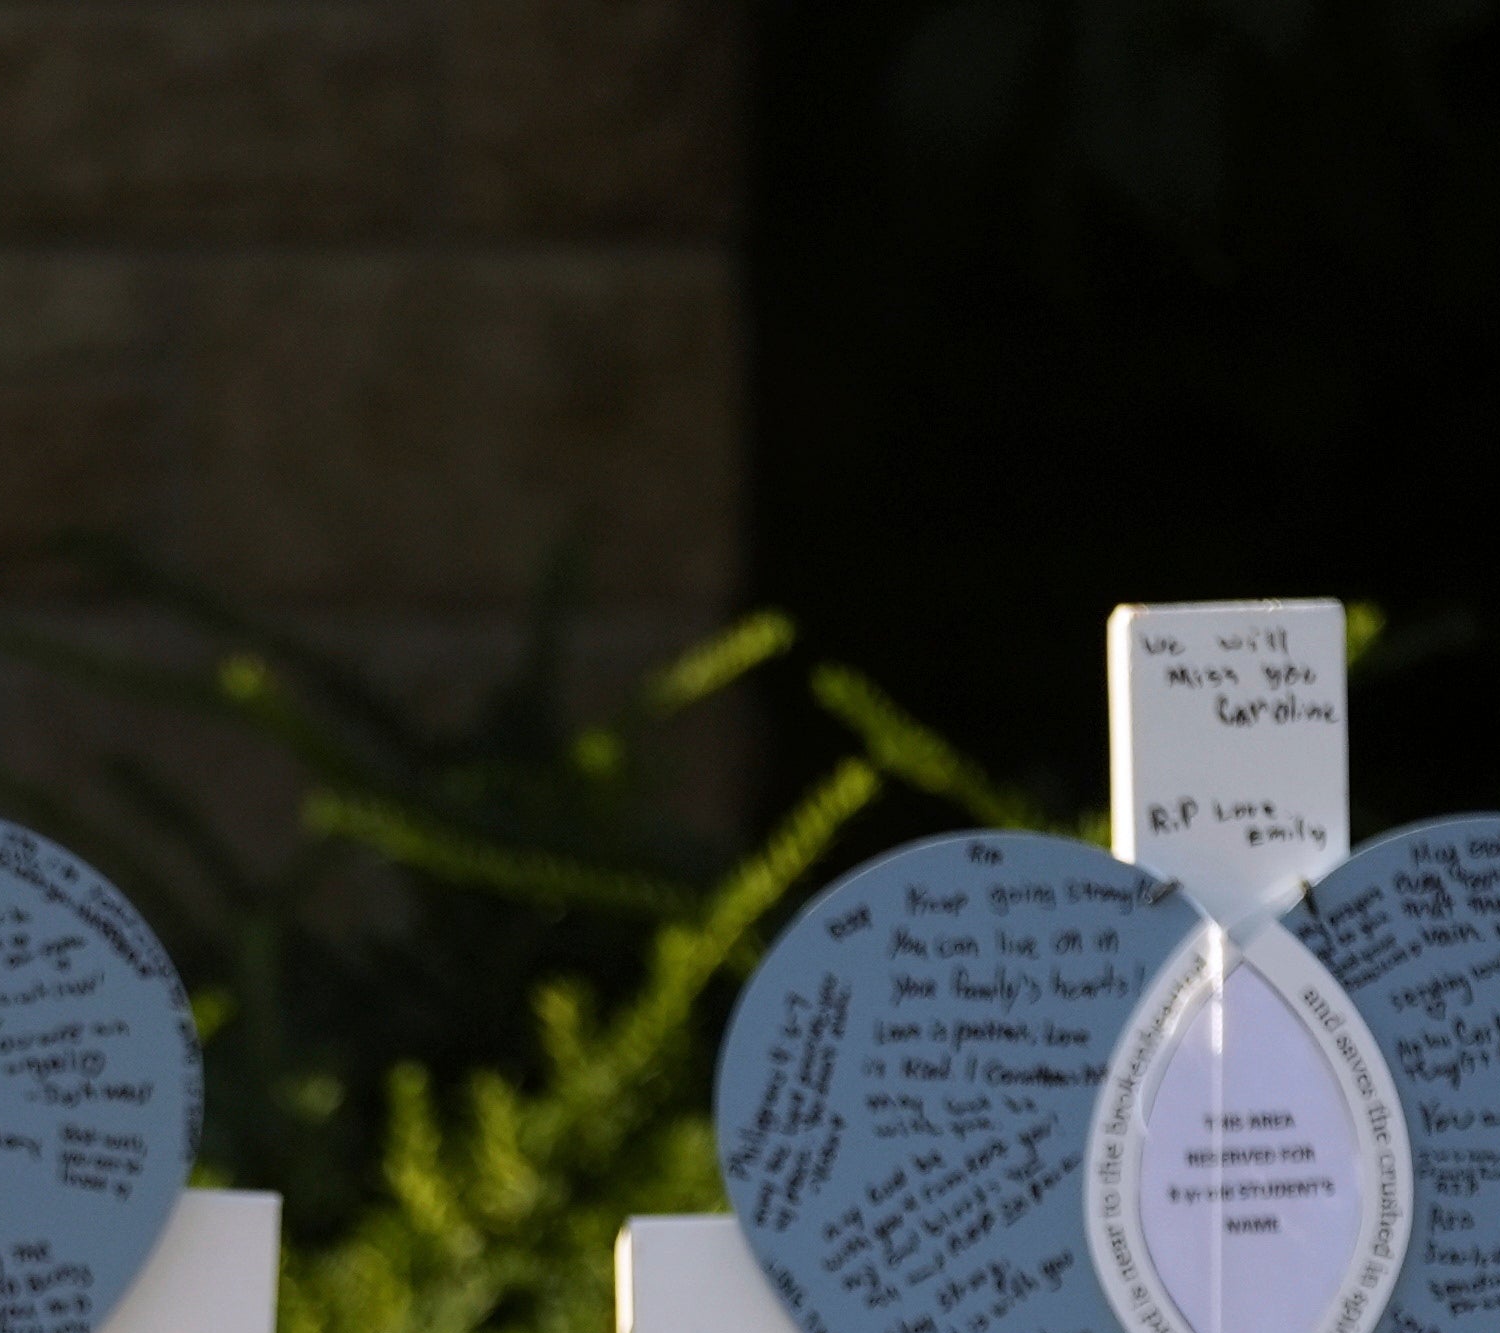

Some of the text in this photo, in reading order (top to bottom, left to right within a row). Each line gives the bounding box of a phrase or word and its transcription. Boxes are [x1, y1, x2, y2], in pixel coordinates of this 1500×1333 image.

[1262, 664, 1317, 690] you
[1215, 692, 1339, 728] Caroline
[935, 933, 980, 959] can
[994, 928, 1040, 960] live
[1303, 987, 1347, 1035] and
[1335, 1034, 1376, 1097] saves
[1249, 1111, 1296, 1131] AREA
[1367, 1102, 1394, 1145] the
[1097, 1141, 1124, 1186] the
[1185, 1144, 1316, 1169] RESERVED FOR
[1373, 1151, 1404, 1258] crushed
[1226, 1216, 1280, 1235] NAME
[1107, 1224, 1138, 1281] near
